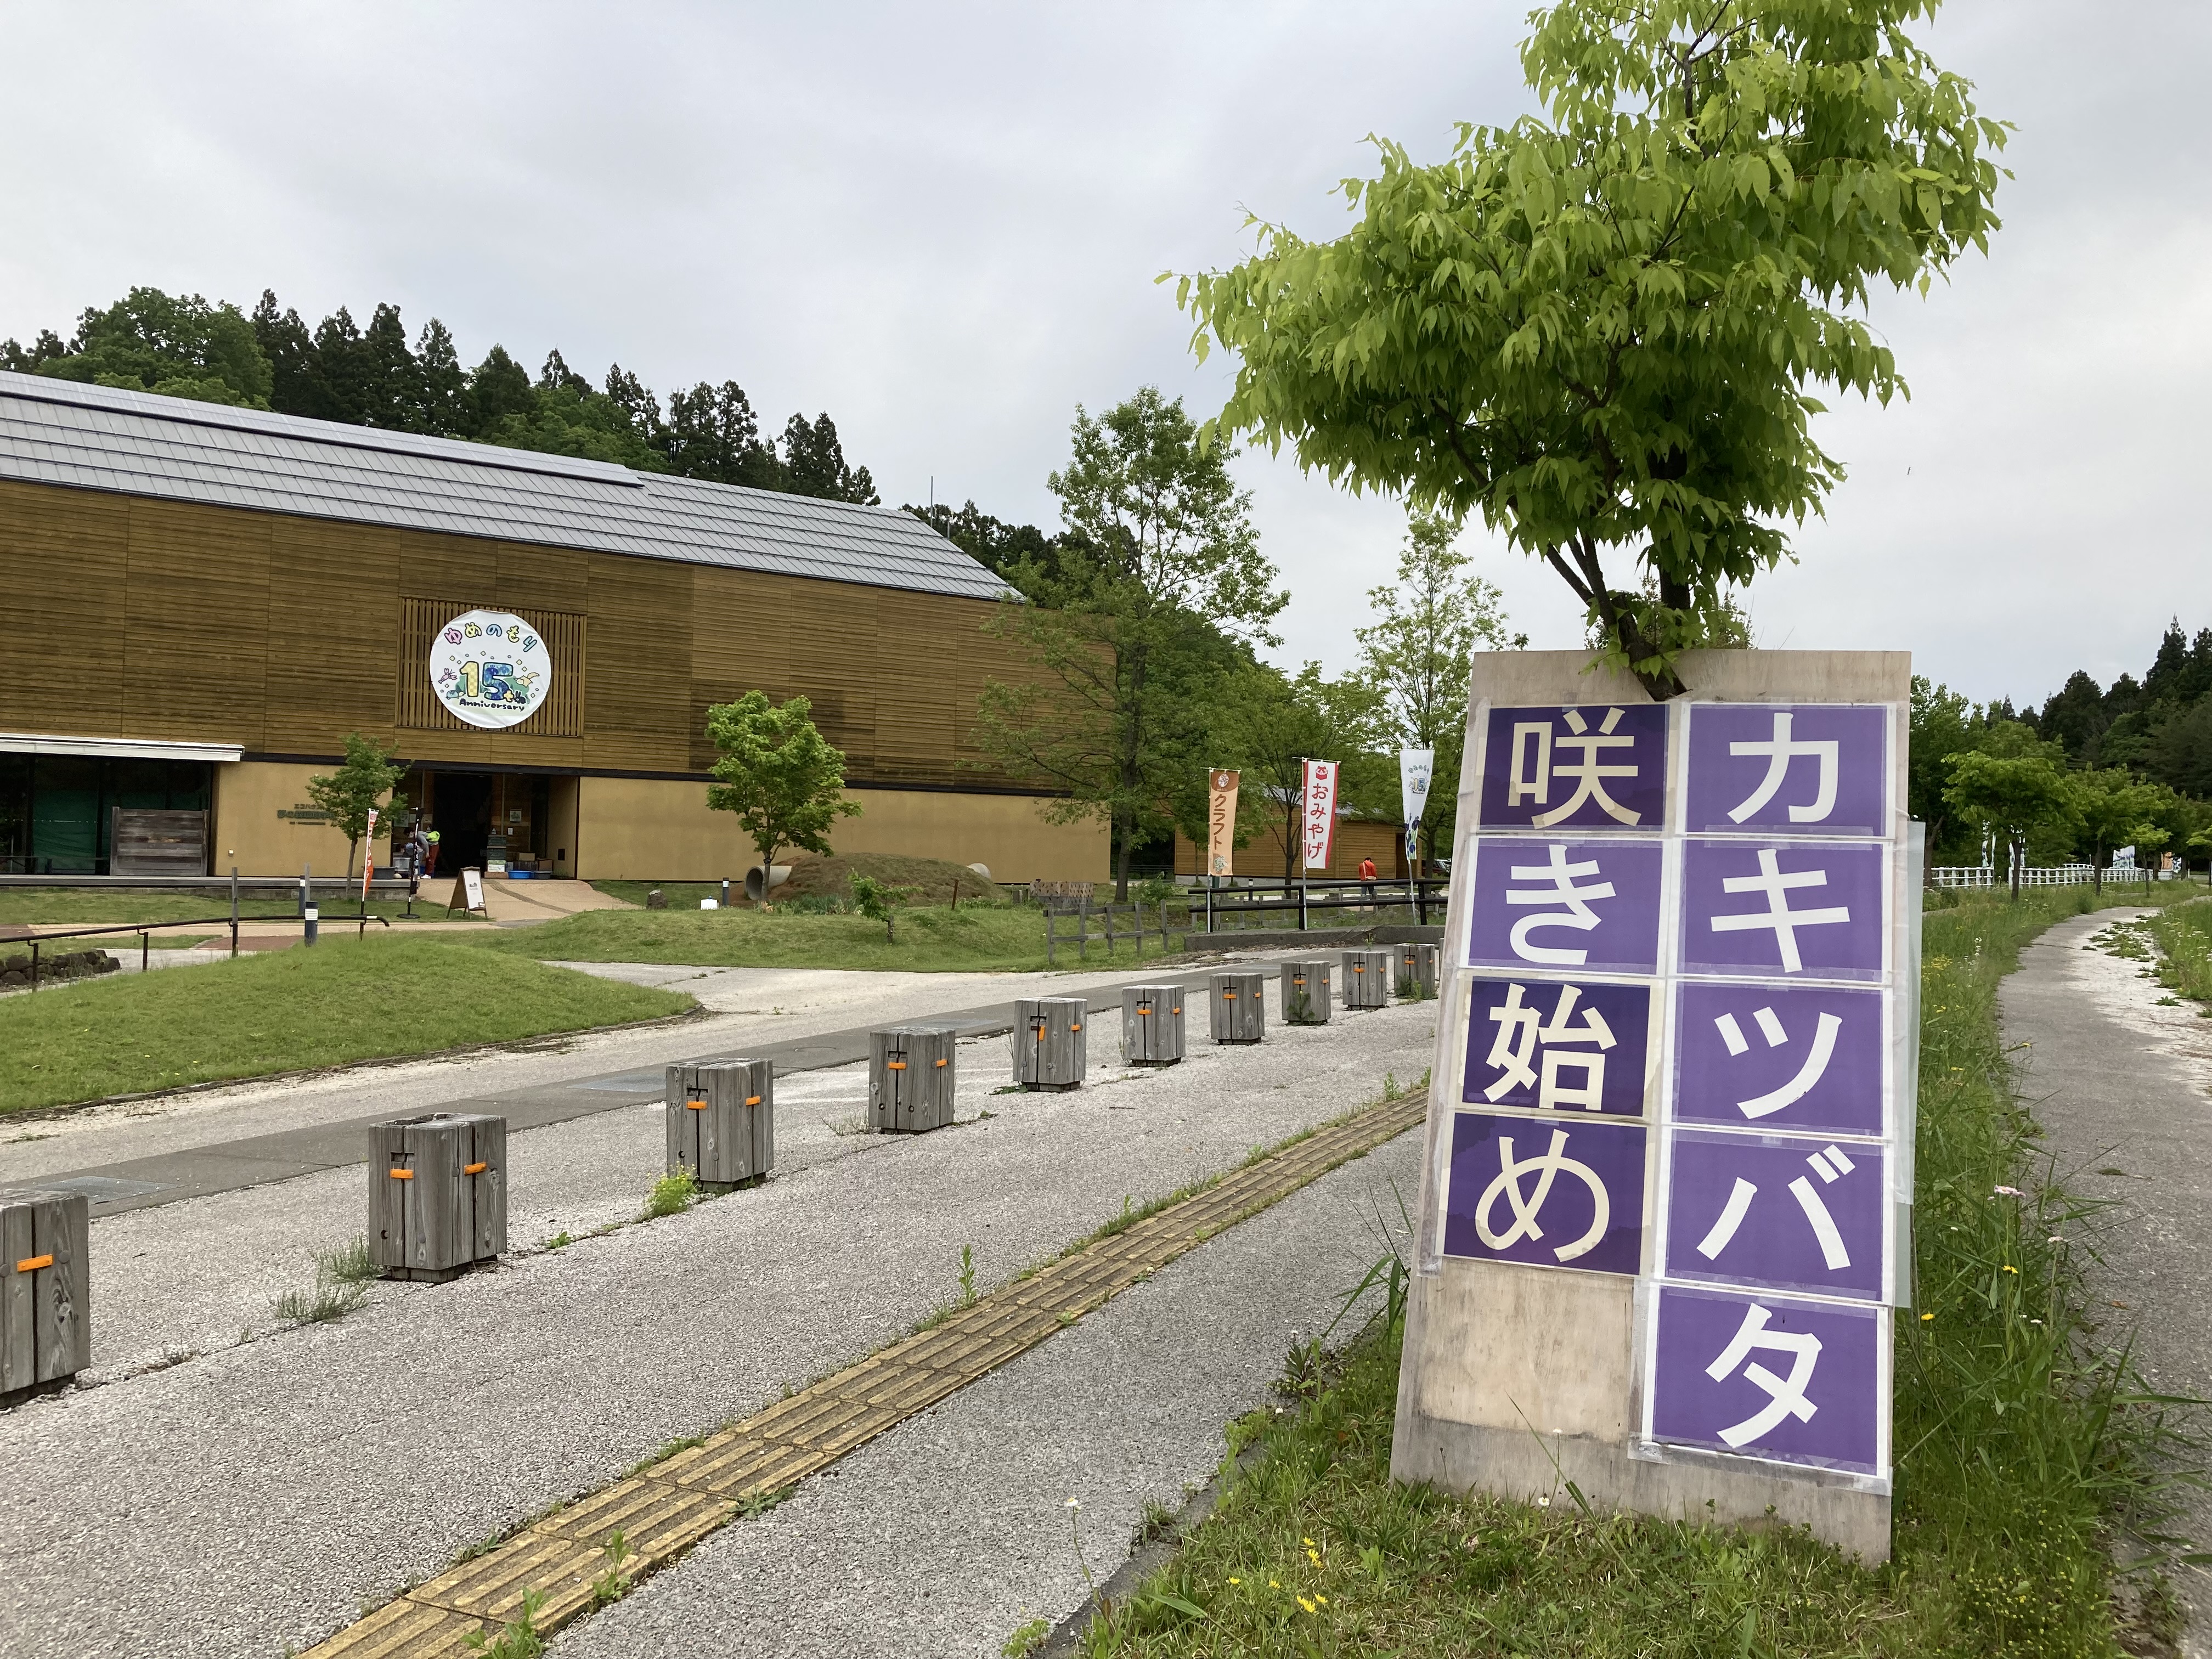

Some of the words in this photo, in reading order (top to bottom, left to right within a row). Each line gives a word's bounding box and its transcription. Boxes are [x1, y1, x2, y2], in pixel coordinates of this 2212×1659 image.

[444, 622, 538, 653] ゆめのもり
[459, 661, 515, 701] 15
[459, 698, 525, 712] Anniversary
[1413, 777, 1425, 792] 15
[1213, 793, 1227, 850] クラフト
[1307, 783, 1329, 860] おみやげ
[1475, 707, 1642, 1262] 咲き始め
[1697, 712, 1855, 1448] カキツバタ
